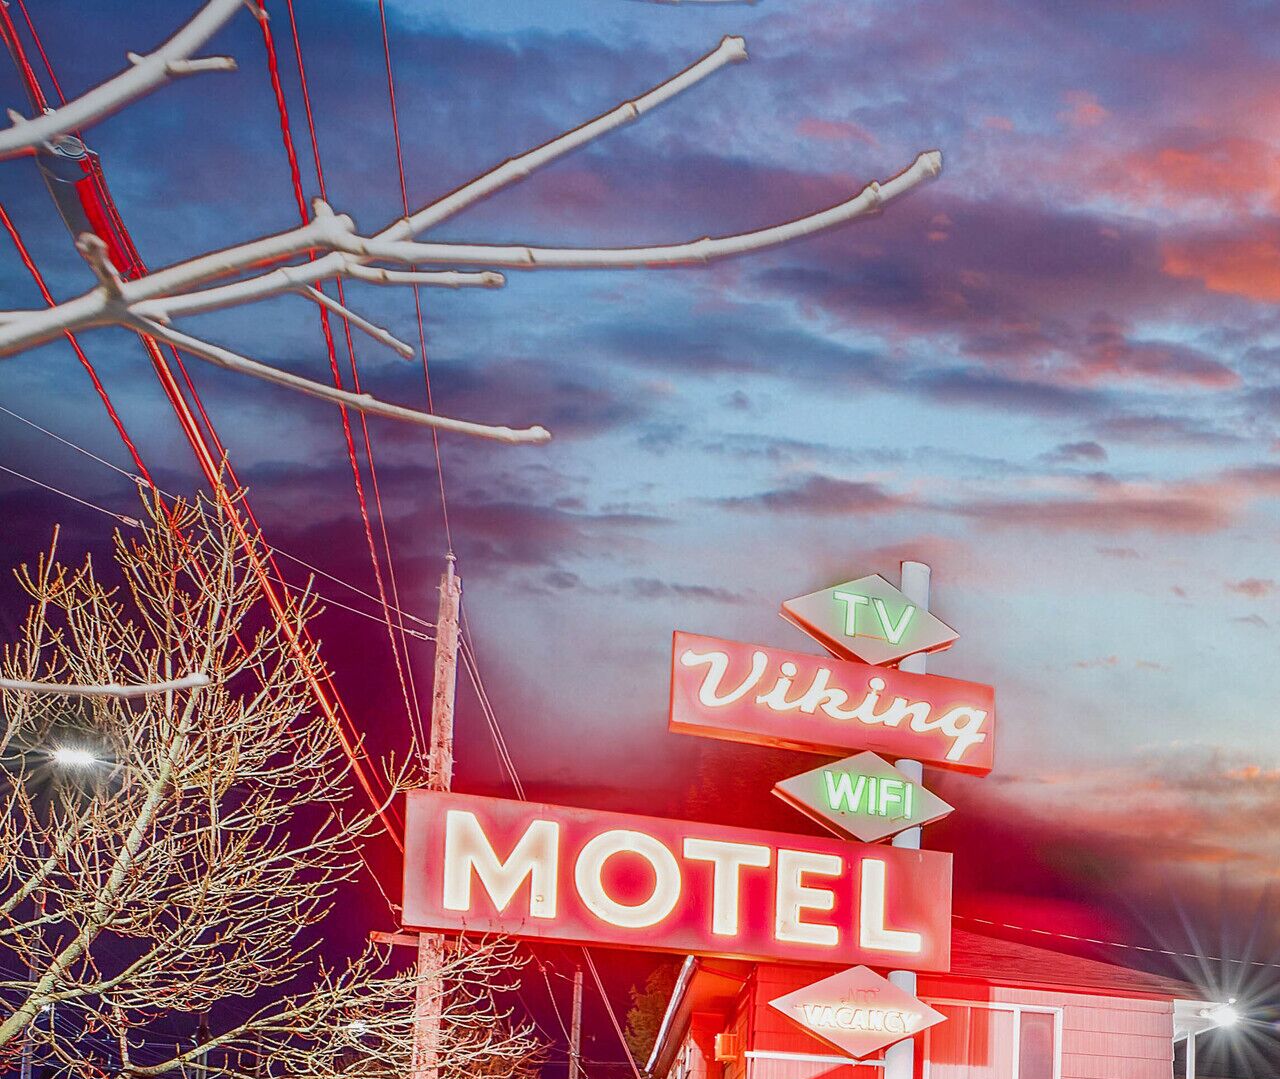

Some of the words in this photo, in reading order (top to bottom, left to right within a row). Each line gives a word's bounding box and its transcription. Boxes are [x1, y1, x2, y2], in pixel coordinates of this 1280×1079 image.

[833, 590, 916, 645] TV
[680, 646, 989, 760] Viking
[823, 769, 914, 821] WIFI
[442, 808, 922, 953] MOTEL
[803, 1003, 922, 1034] VACANCY
